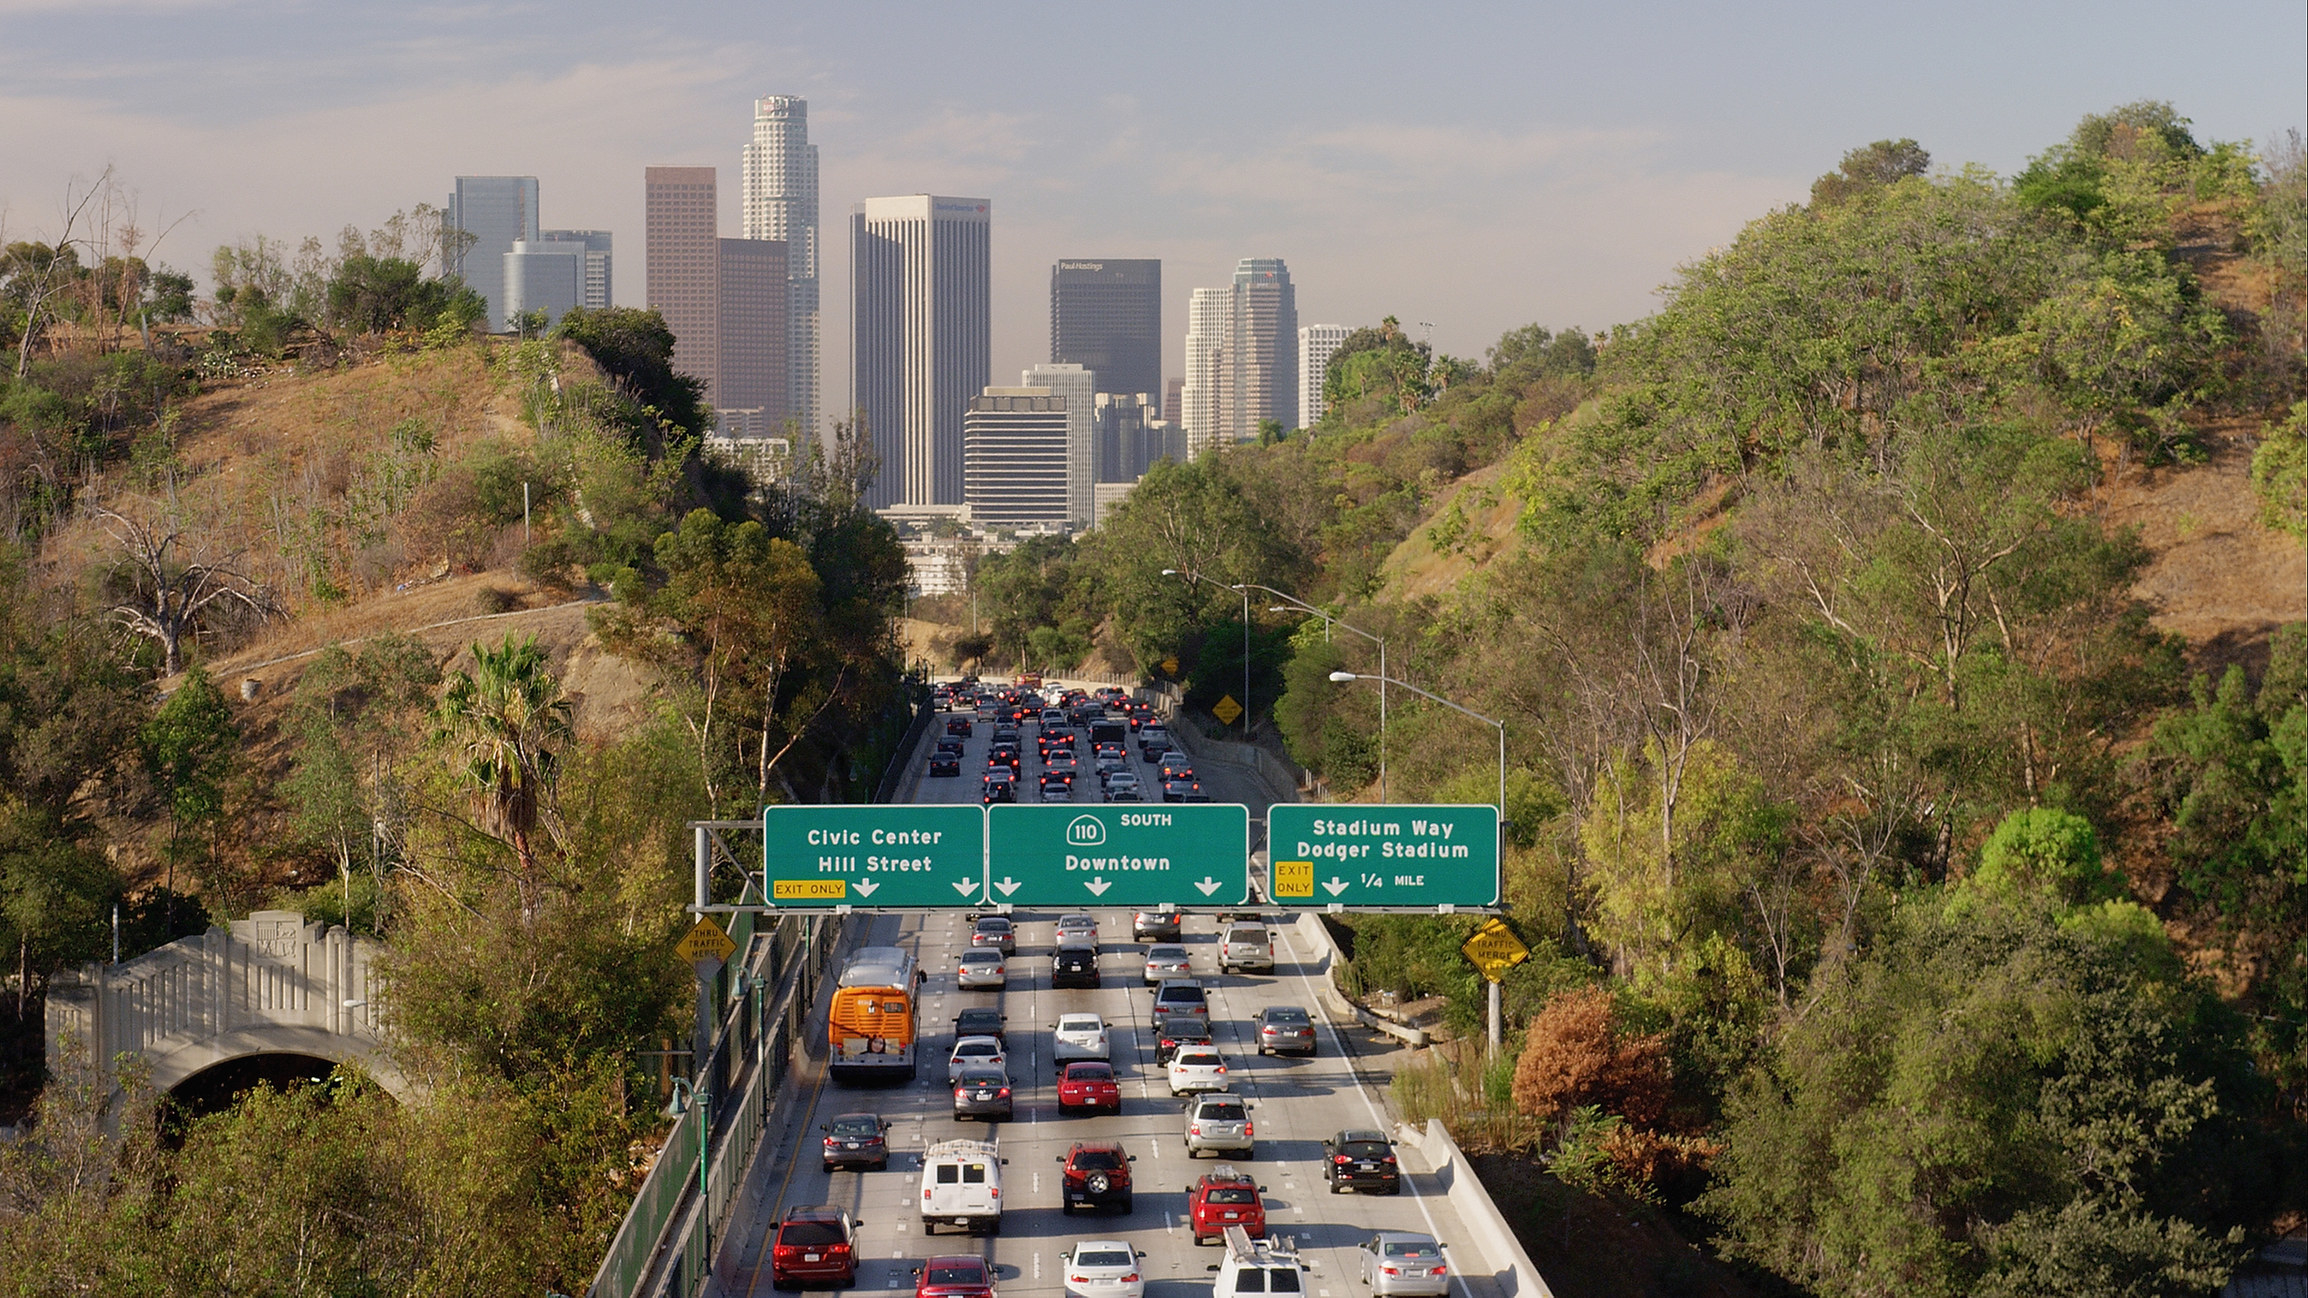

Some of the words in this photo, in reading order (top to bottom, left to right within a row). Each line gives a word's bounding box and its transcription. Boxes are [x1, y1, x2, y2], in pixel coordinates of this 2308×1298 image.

[1061, 262, 1075, 270] Paul
[1076, 262, 1103, 272] Hastings
[1120, 813, 1172, 826] SOUTH
[1075, 824, 1098, 840] 110
[1312, 819, 1400, 836] Stadium
[1411, 819, 1454, 839] Way
[807, 829, 860, 846] Civic
[871, 828, 942, 845] Center
[1297, 841, 1370, 862] Dodger
[1381, 841, 1469, 858] Stadium
[818, 856, 856, 873] Hill
[866, 855, 932, 873] Street
[1065, 854, 1170, 871] Downtown
[1278, 865, 1310, 876] EXIT
[1360, 872, 1383, 888] 1/4
[1394, 875, 1425, 886] MILE
[775, 884, 804, 895] EXIT
[810, 884, 843, 895] ONLY
[1277, 882, 1310, 893] ONLY
[694, 929, 718, 937] THRU
[689, 938, 725, 948] TRAFFIC
[1477, 940, 1514, 949] TRAFFIC
[1478, 951, 1512, 960] MERGE
